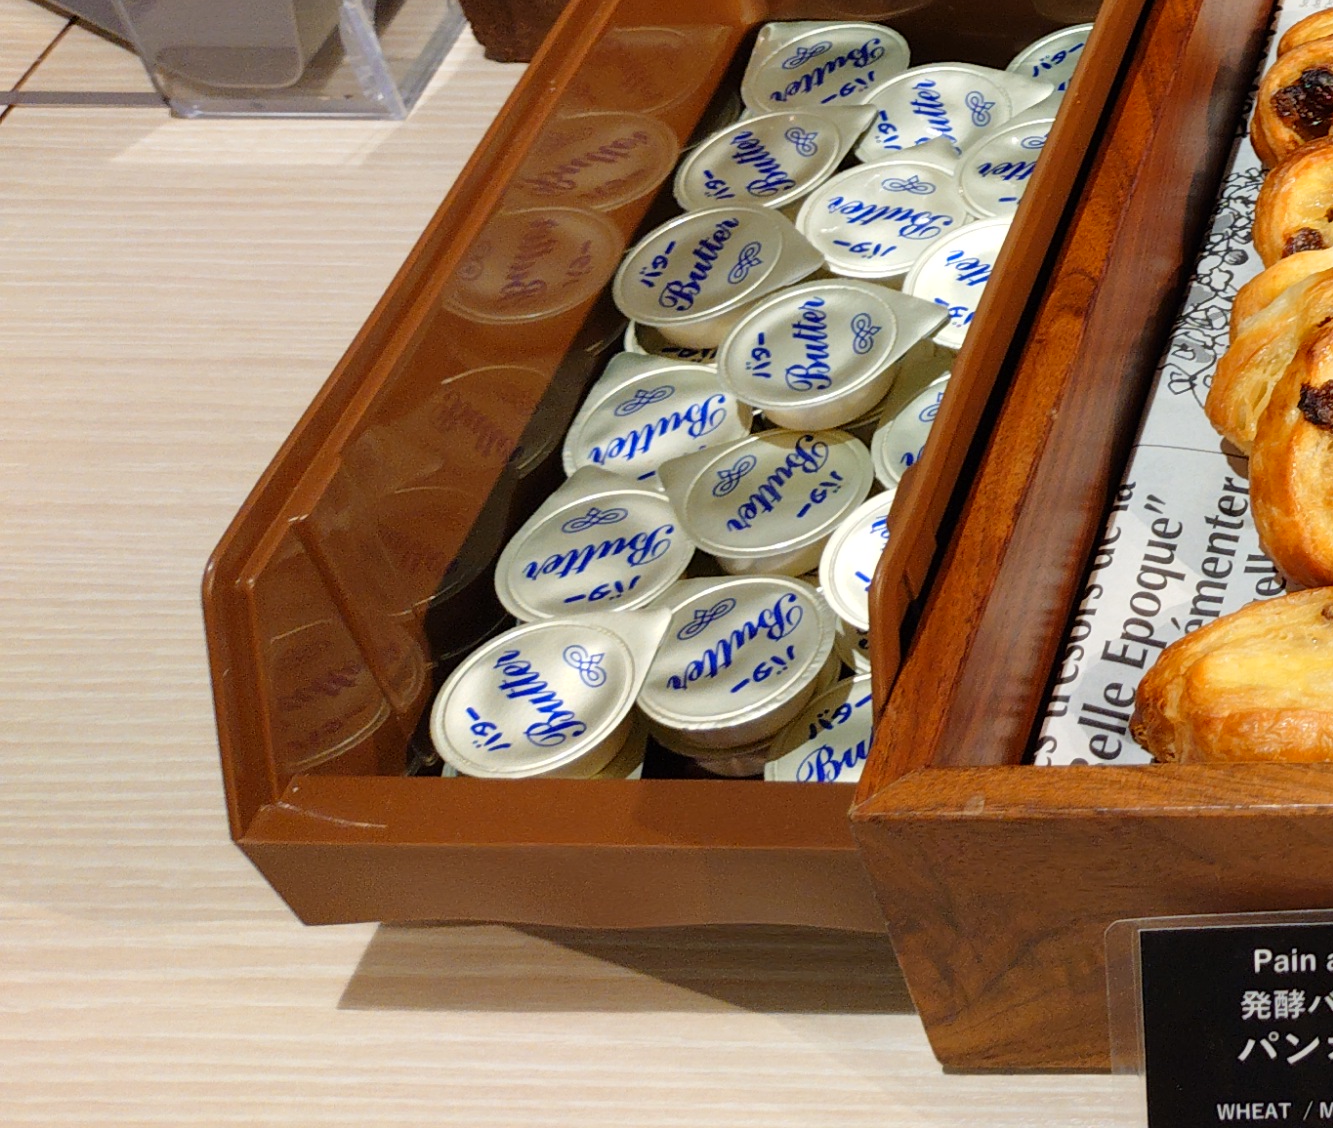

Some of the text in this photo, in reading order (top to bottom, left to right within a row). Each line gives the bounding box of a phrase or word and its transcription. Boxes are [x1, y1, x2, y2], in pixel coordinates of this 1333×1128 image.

[769, 37, 886, 103] Butter
[821, 70, 876, 104] バター
[910, 78, 963, 156] utter
[702, 169, 736, 201] バター
[729, 130, 797, 198] Butter
[977, 161, 1036, 182] tter
[826, 195, 954, 241] Butter
[637, 240, 678, 289] バター
[658, 216, 740, 312] Butter
[832, 238, 898, 260] バター
[746, 332, 766, 379] バター
[785, 295, 828, 392] Butter
[589, 393, 727, 465] Butter
[726, 434, 831, 533] Butter
[796, 469, 844, 519] バター
[523, 524, 675, 581] Butter
[1170, 476, 1250, 634] émenter
[562, 574, 642, 604] バター
[667, 592, 804, 692] Butter
[729, 644, 797, 695] バター
[491, 649, 587, 751] Butter
[1073, 681, 1137, 765] elle
[465, 706, 512, 753] バター
[1252, 947, 1317, 974] Pain
[1216, 1101, 1292, 1121] WHEAT
